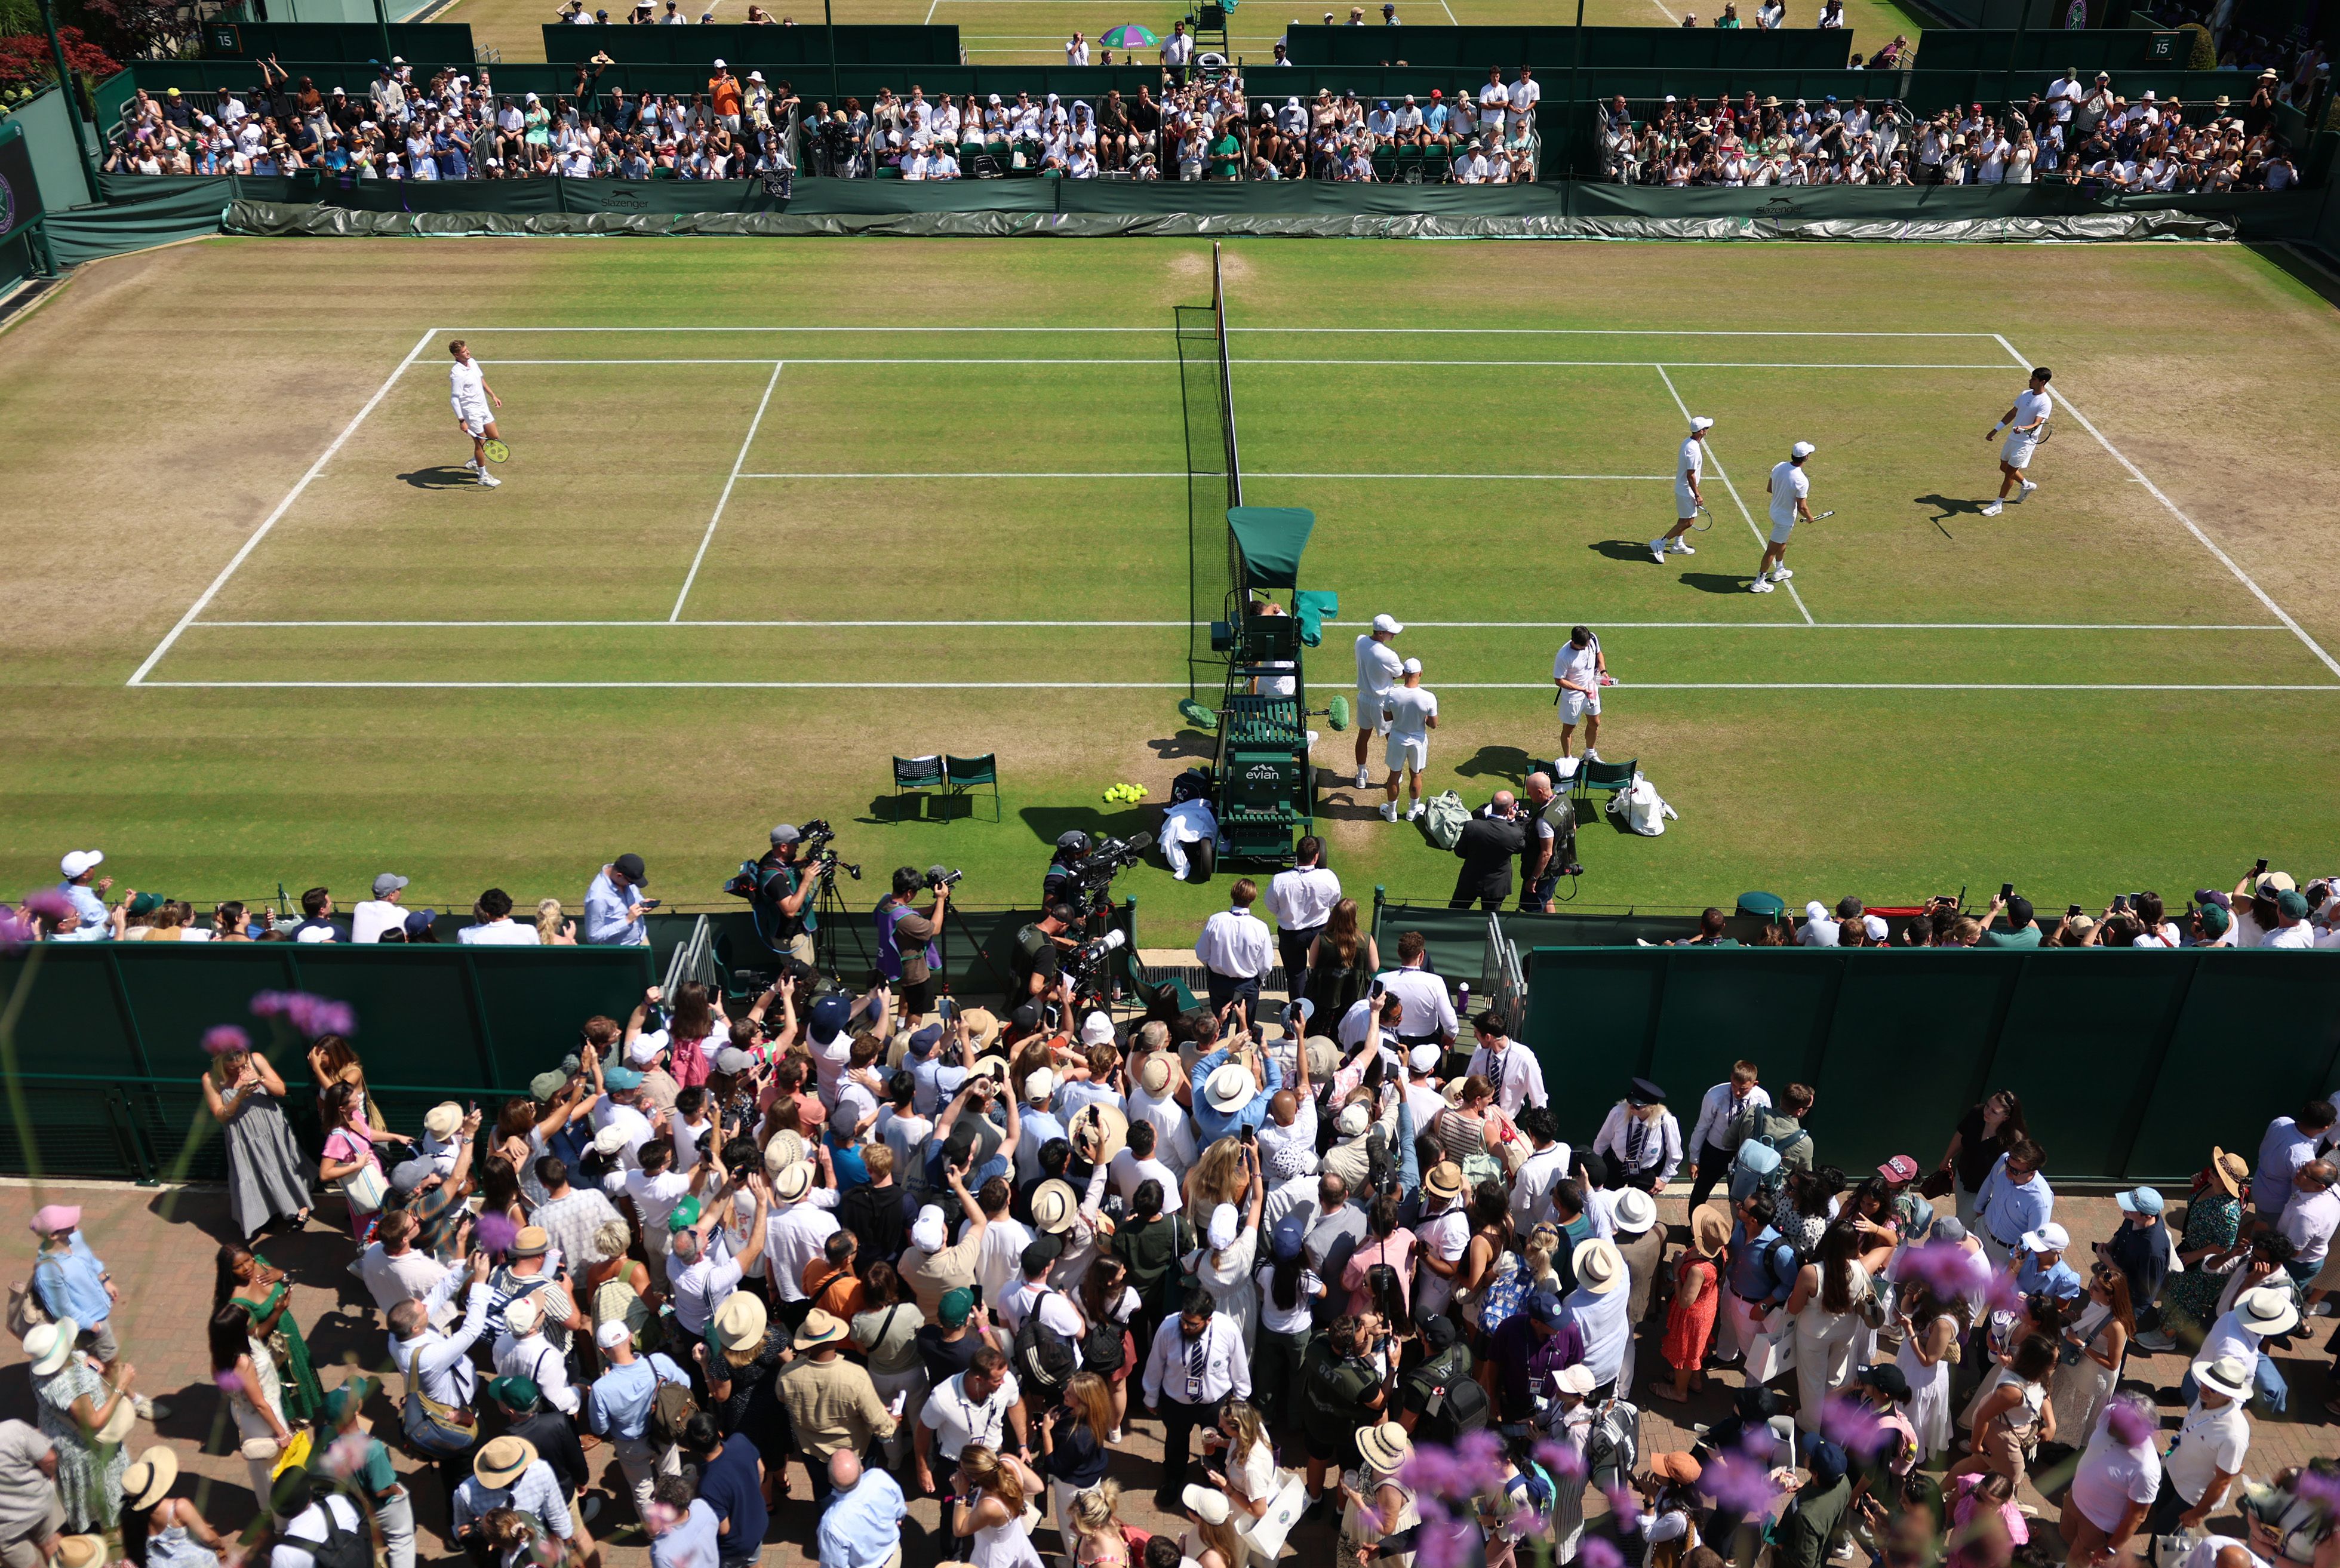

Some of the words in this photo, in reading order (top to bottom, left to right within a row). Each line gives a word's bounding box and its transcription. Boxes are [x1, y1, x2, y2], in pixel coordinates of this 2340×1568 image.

[218, 36, 232, 46] 15
[2156, 43, 2169, 54] 15
[601, 198, 648, 210] Slazenger
[1755, 205, 1803, 215] Slazenger
[1246, 770, 1280, 779] evian
